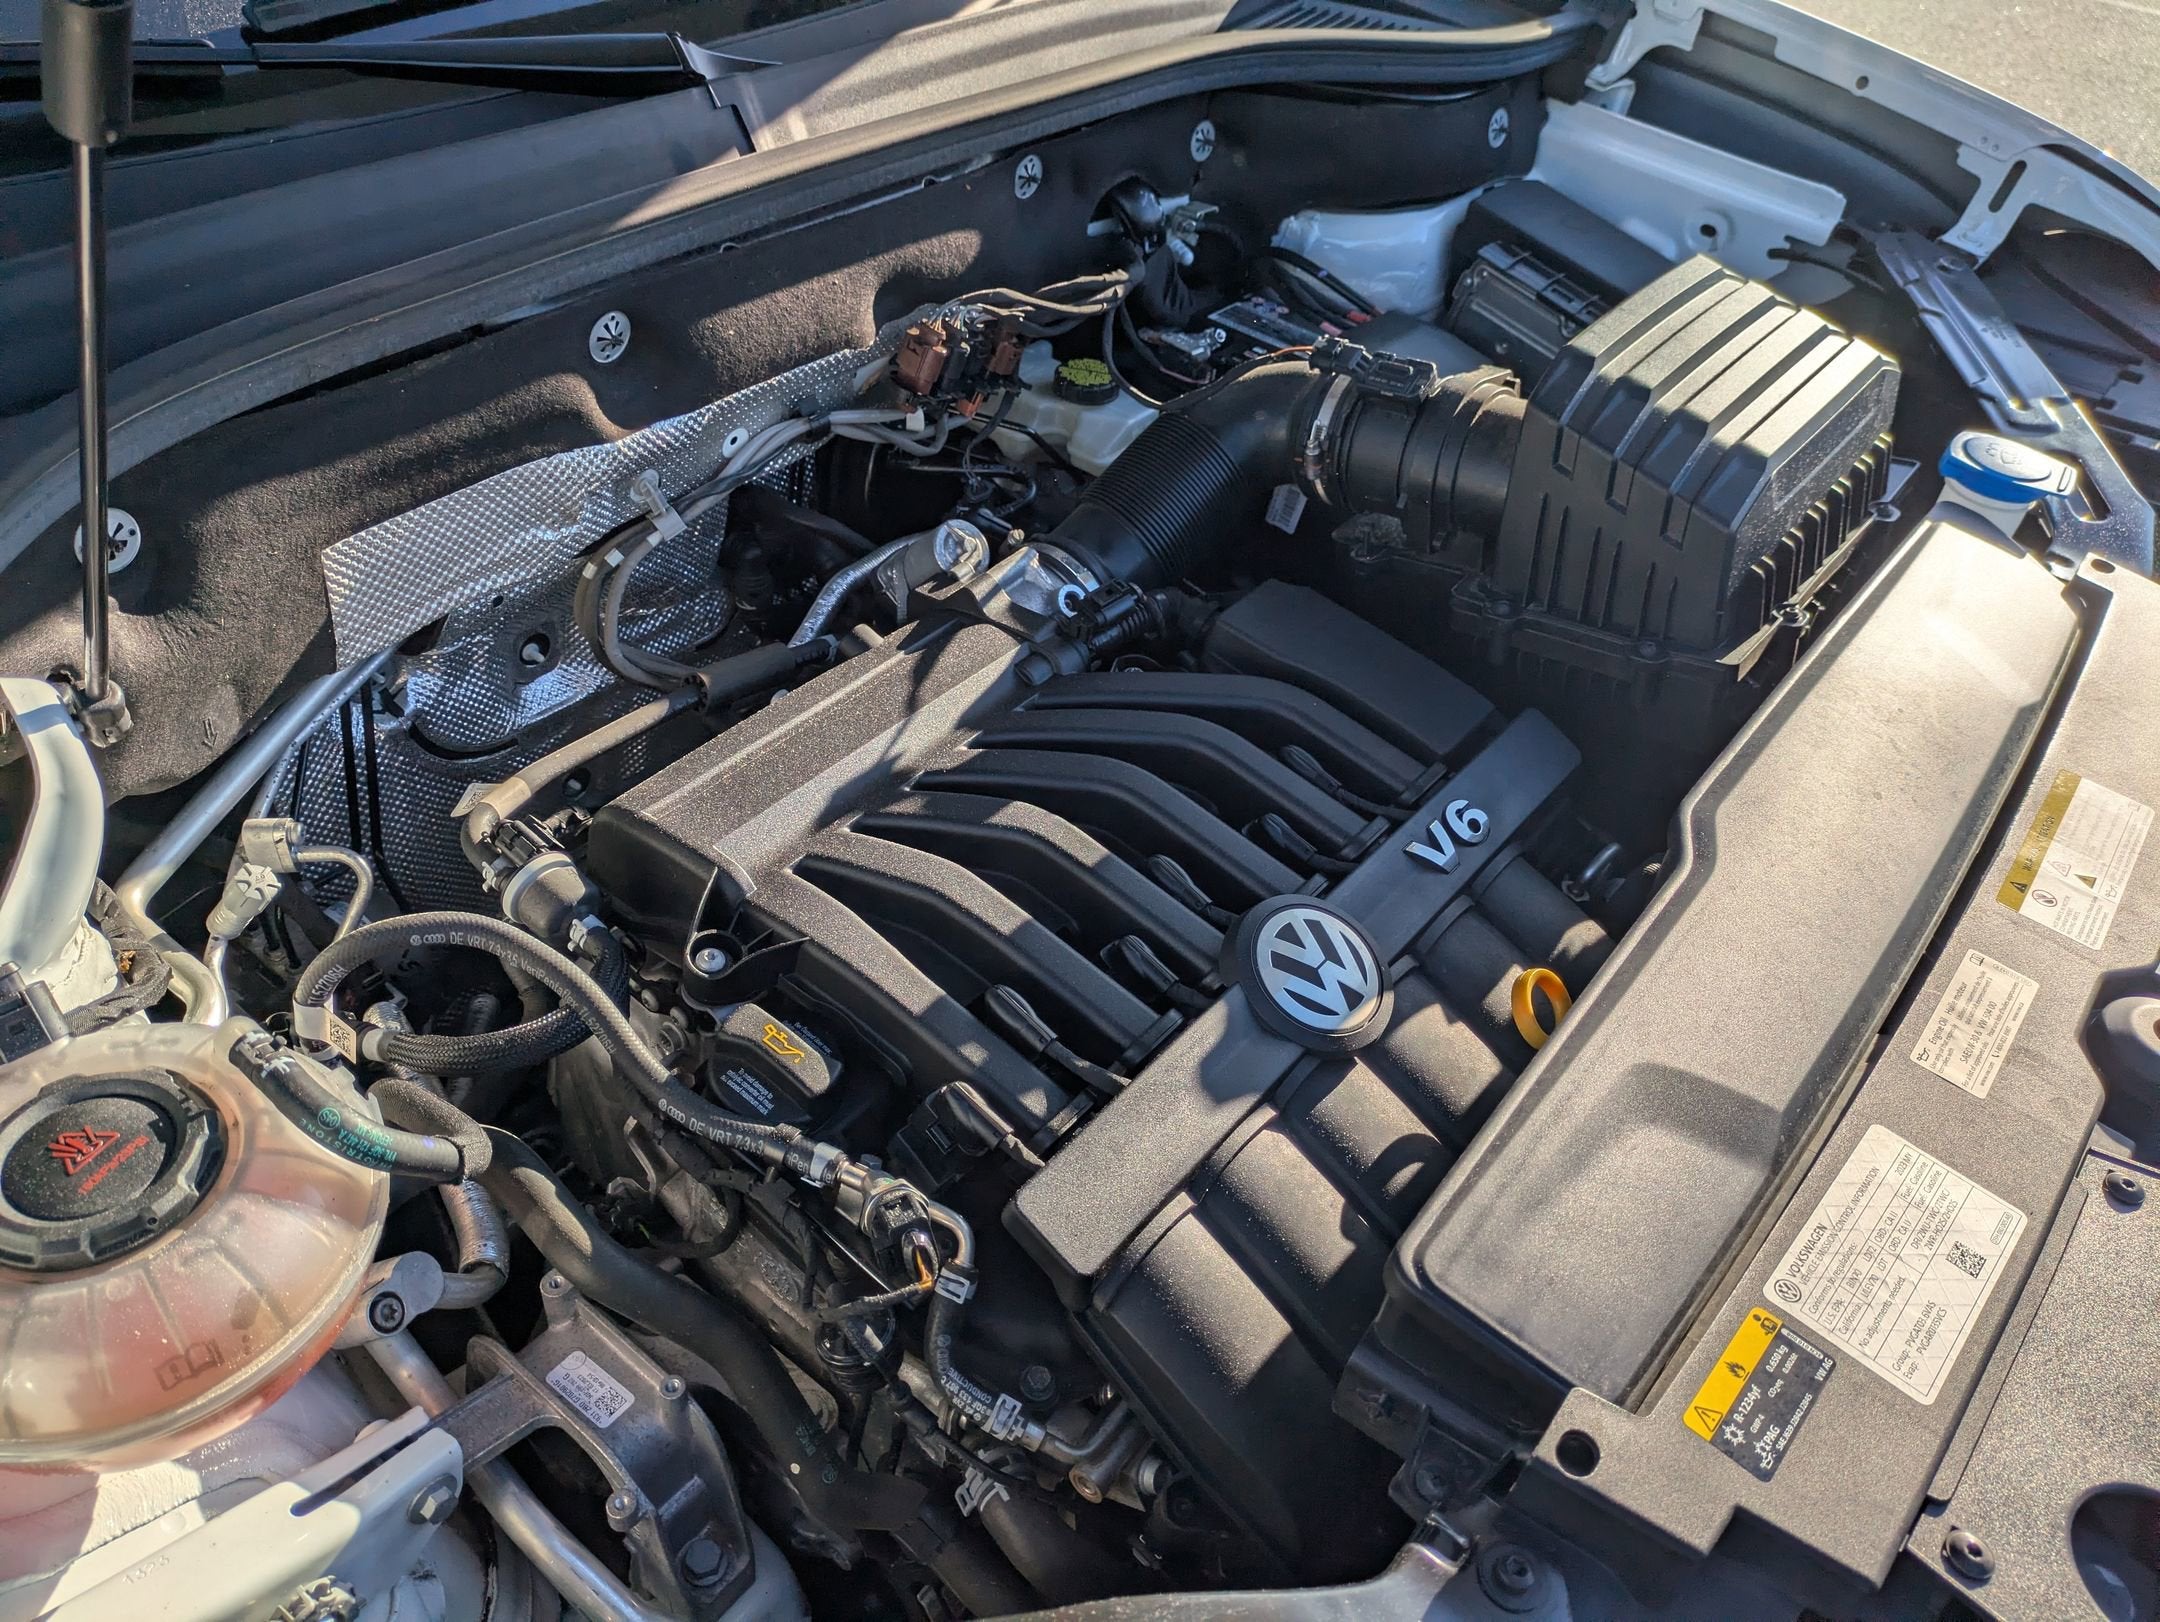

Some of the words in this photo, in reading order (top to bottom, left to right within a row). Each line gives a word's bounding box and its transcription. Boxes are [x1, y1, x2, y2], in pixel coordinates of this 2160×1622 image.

[1403, 800, 1490, 873] V6
[1944, 1001, 1958, 1015] Huile
[1953, 982, 1967, 1001] moteur
[1928, 1026, 1944, 1045] Engine
[1938, 1016, 1949, 1027] Oil
[1977, 1018, 1988, 1029] VW
[299, 1118, 364, 1160] TRISTONE
[689, 1117, 705, 1137] DE
[708, 1126, 733, 1147] VRT
[1894, 1161, 1908, 1176] 2023
[1902, 1153, 1912, 1164] MY
[1909, 1162, 1929, 1185] Gasoline
[1923, 1170, 1942, 1193] Gasoline
[1799, 1259, 1820, 1286] VEHICLE
[1814, 1231, 1839, 1262] EMISSION
[1833, 1205, 1856, 1233] CONTROL
[1851, 1167, 1879, 1205] INFORMATION
[1884, 1216, 1895, 1226] CA
[1897, 1225, 1909, 1235] CA
[1786, 1222, 1828, 1278] VOLKSWAGEN
[1808, 1283, 1832, 1314] Conforms
[1827, 1277, 1836, 1286] to
[1858, 1338, 1870, 1348] No
[1865, 1299, 1893, 1339] adjustments
[1766, 1352, 1782, 1372] 0.650
[1776, 1345, 1789, 1355] kg
[1814, 1367, 1827, 1381] VW
[1822, 1357, 1833, 1370] AG
[1892, 1348, 1911, 1372] Group:
[1903, 1361, 1919, 1380] Evap:
[947, 1367, 992, 1404] CONDUCTIVE
[959, 1390, 972, 1403] 133
[1733, 1384, 1761, 1423] R-1234yf
[1762, 1424, 1780, 1445] PAG
[1776, 1437, 1787, 1451] SAE
